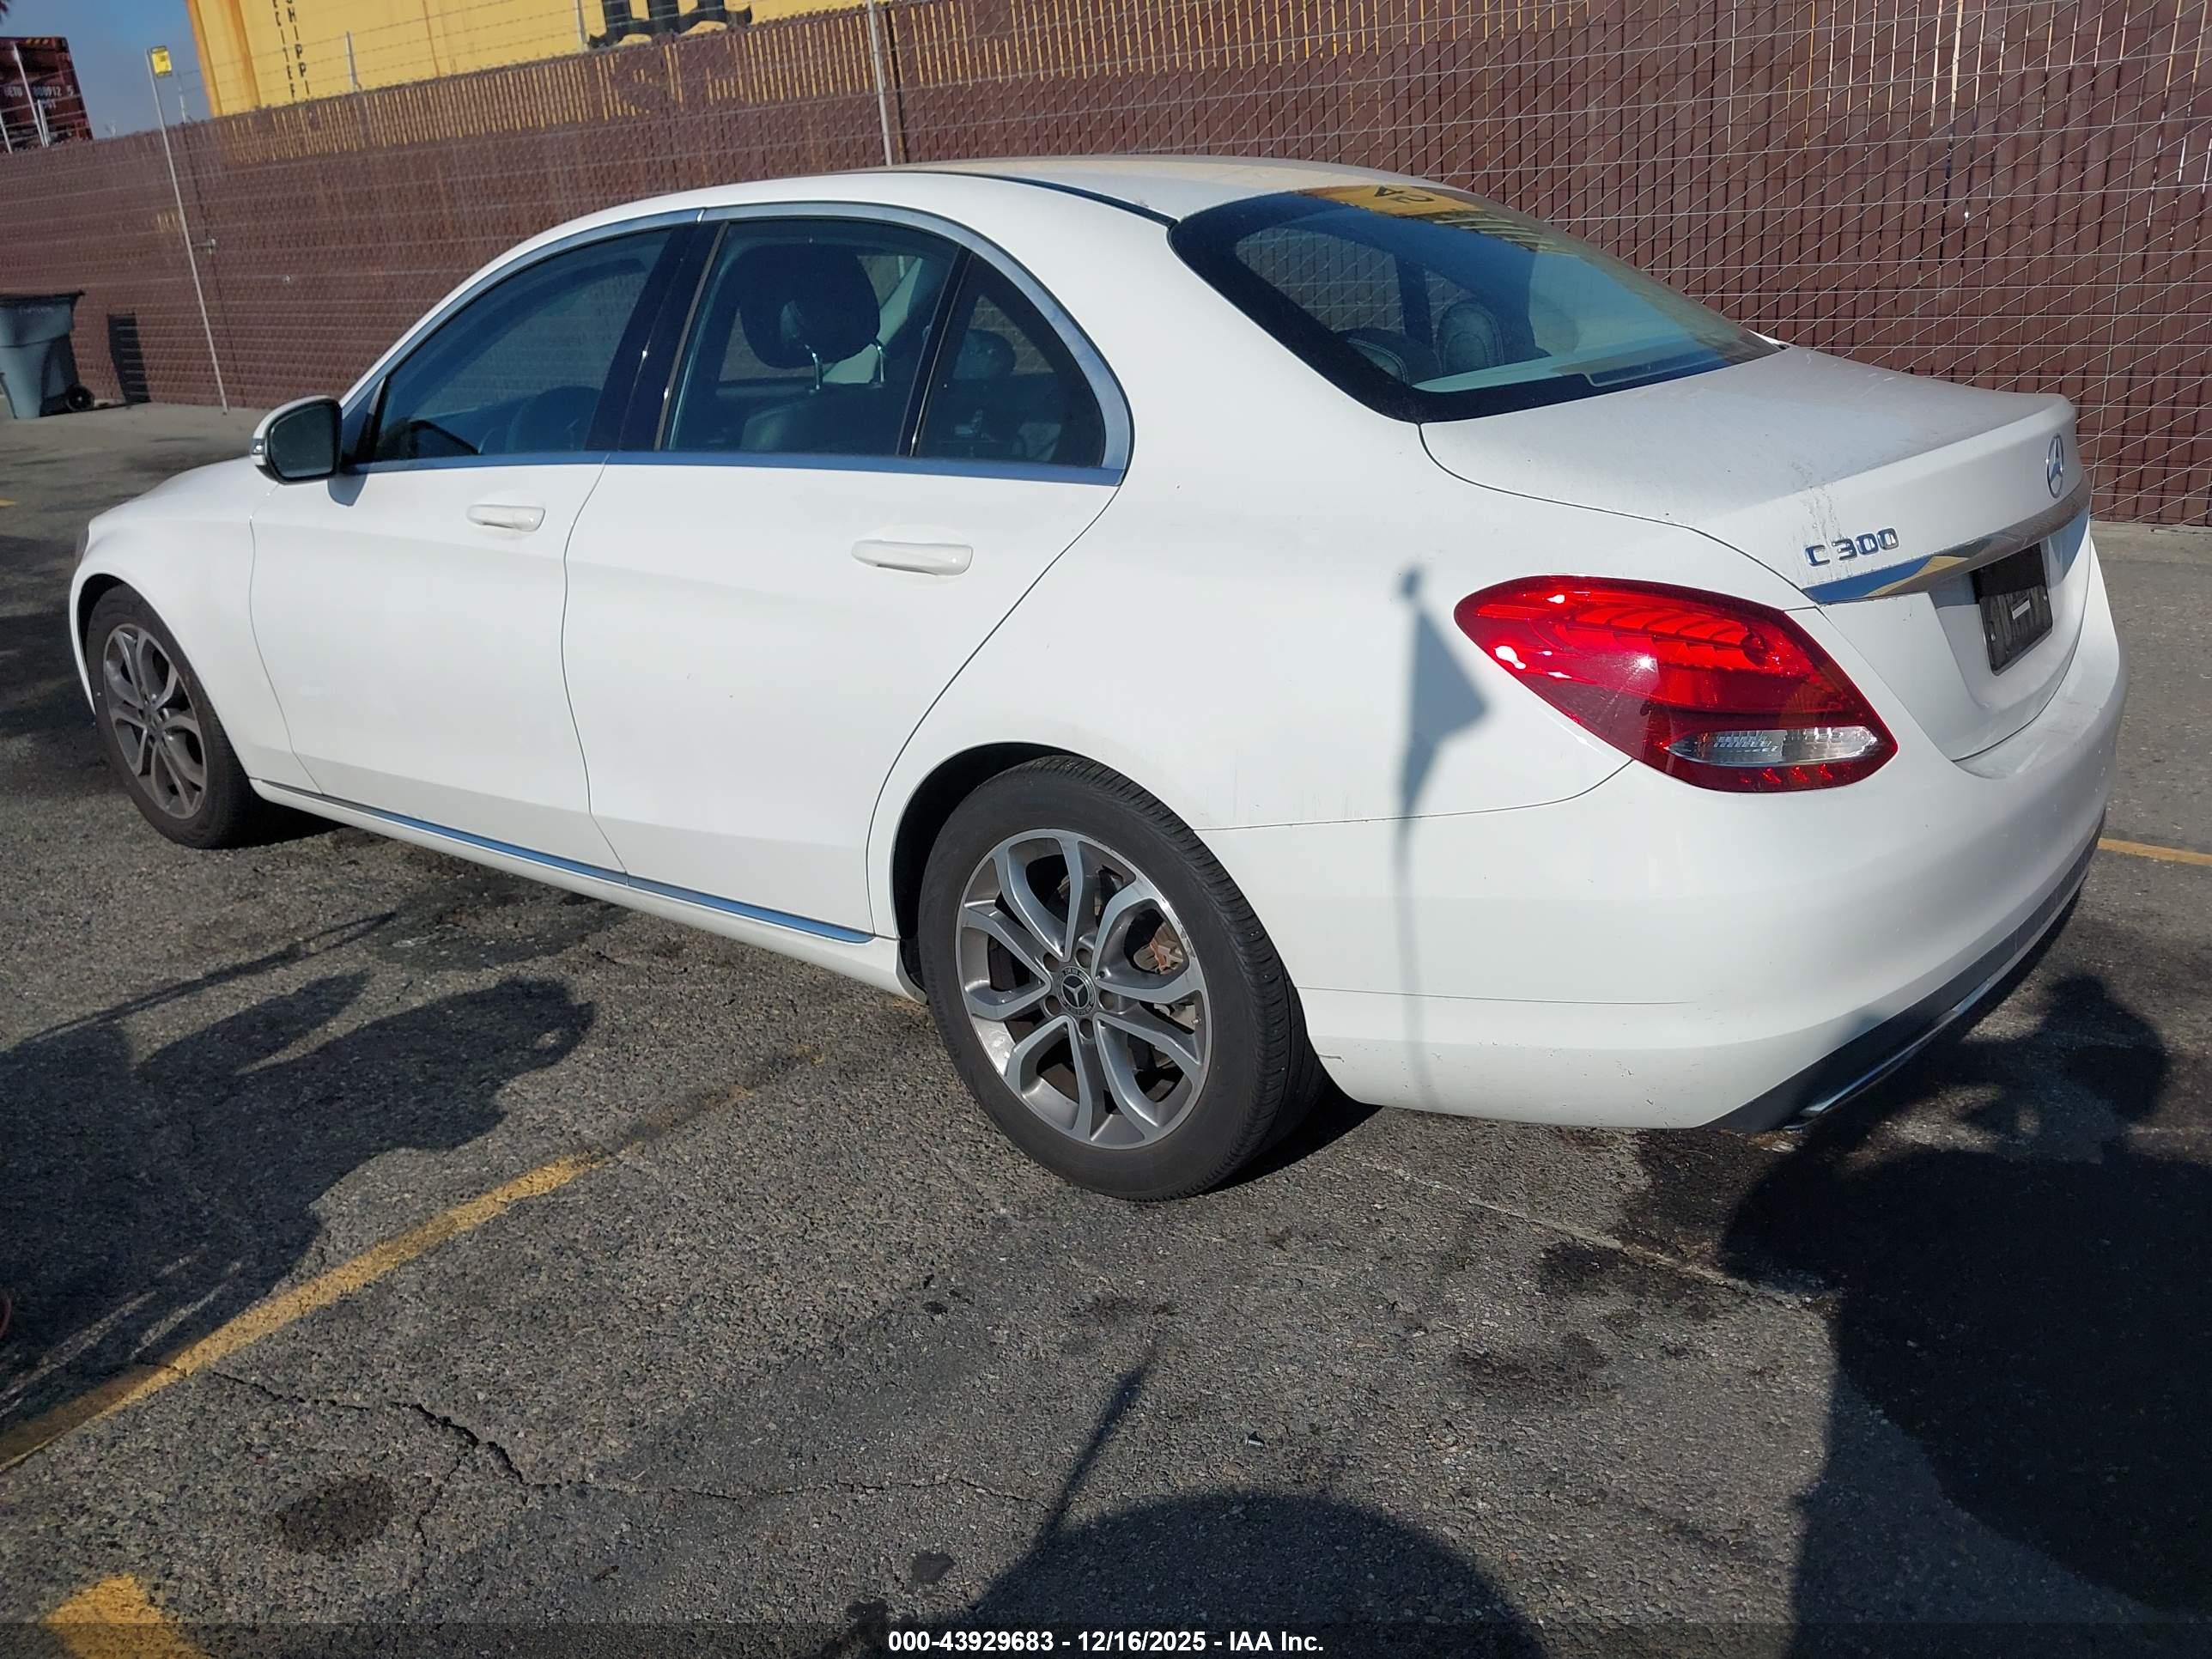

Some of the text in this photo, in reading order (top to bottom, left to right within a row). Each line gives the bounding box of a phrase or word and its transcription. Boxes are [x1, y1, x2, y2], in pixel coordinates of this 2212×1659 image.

[286, 0, 310, 95] HIPPI
[1805, 528, 1899, 567] C 300
